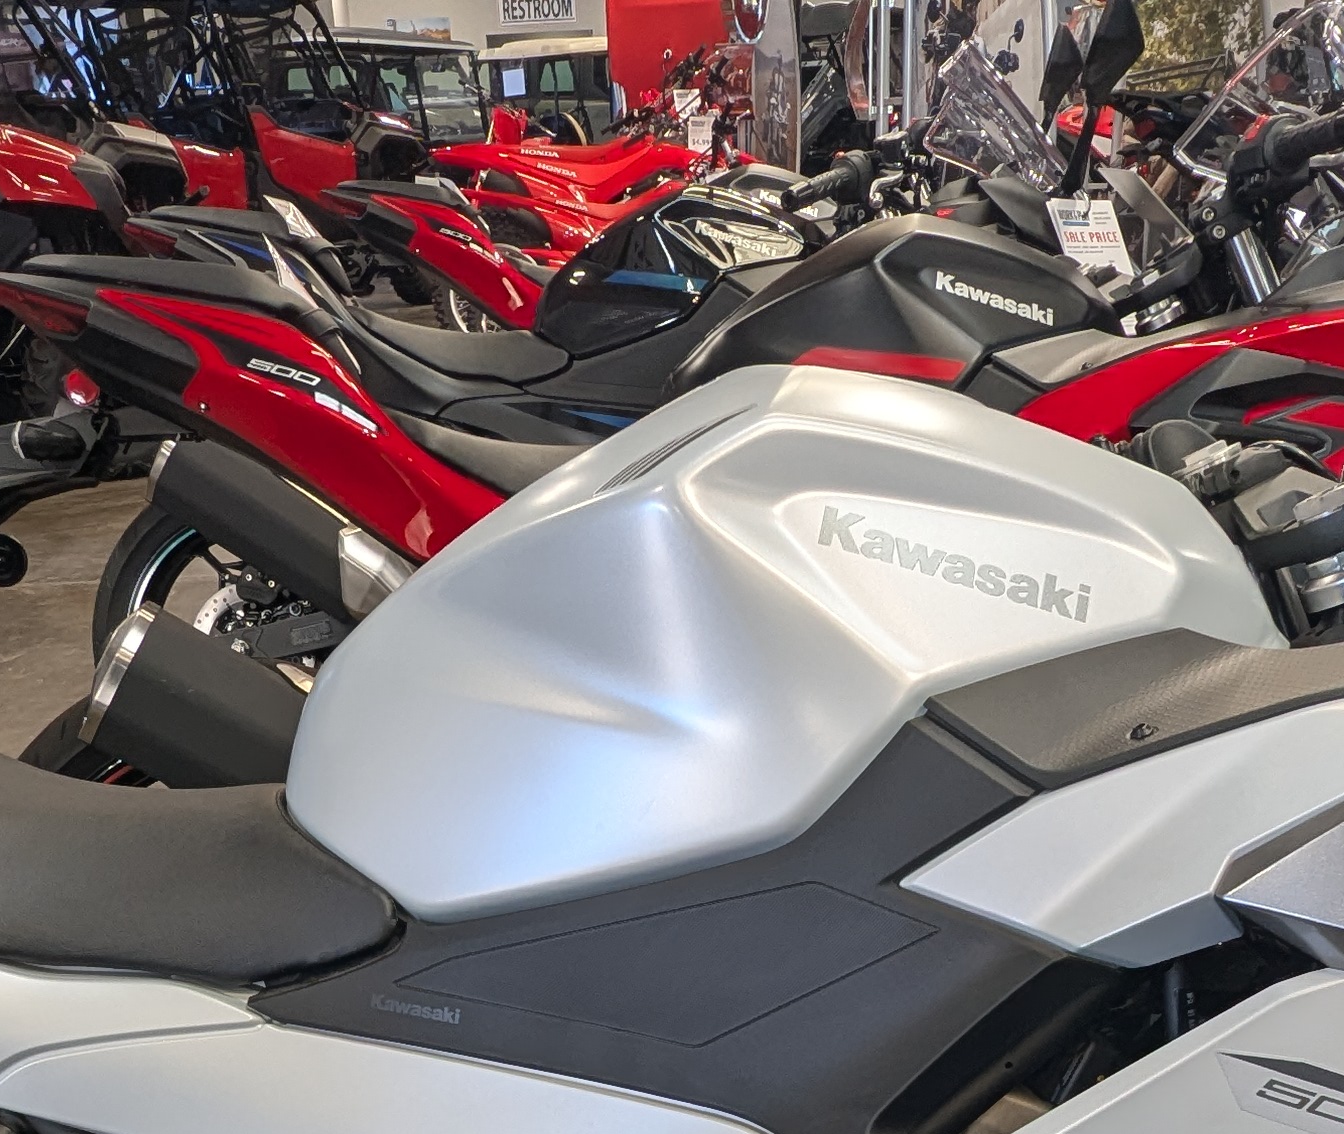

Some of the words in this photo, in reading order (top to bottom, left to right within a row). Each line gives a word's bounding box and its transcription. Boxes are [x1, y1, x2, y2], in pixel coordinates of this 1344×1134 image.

[502, 0, 574, 20] RESTROOM
[520, 148, 560, 158] HONDA
[536, 162, 578, 178] HONDA
[694, 219, 777, 257] Kawasaki
[1063, 230, 1087, 243] SALE
[1089, 230, 1120, 243] PRICE
[935, 270, 1054, 327] Kawasaki
[246, 357, 322, 386] 500
[817, 504, 1092, 623] Kawasaki
[370, 994, 461, 1025] Kawasaki
